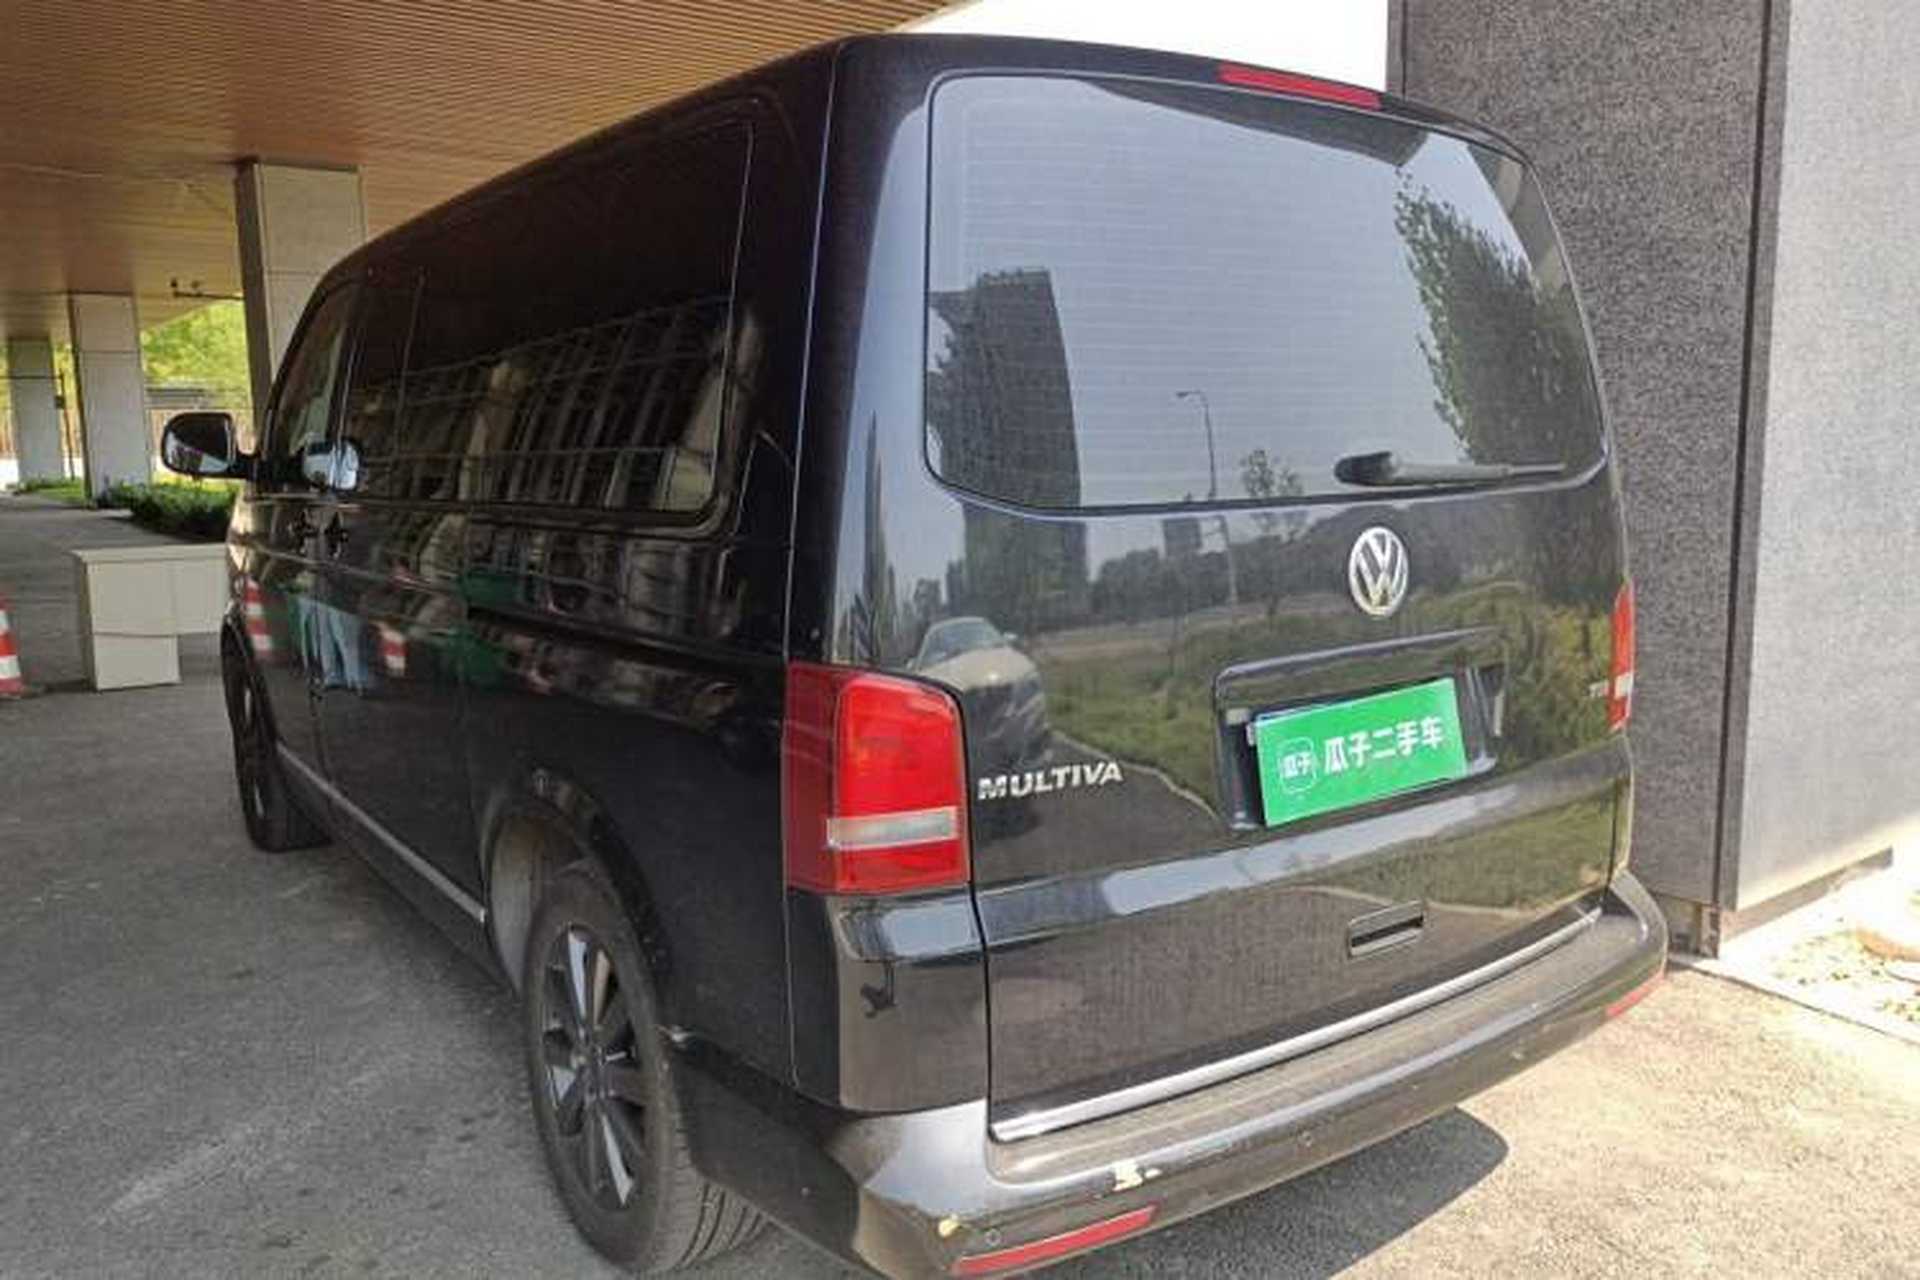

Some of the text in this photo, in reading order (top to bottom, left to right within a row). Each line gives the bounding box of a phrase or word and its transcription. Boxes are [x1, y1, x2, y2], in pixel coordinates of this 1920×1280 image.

[1324, 715, 1444, 775] 瓜子二手车
[978, 761, 1123, 800] MULTIVA
